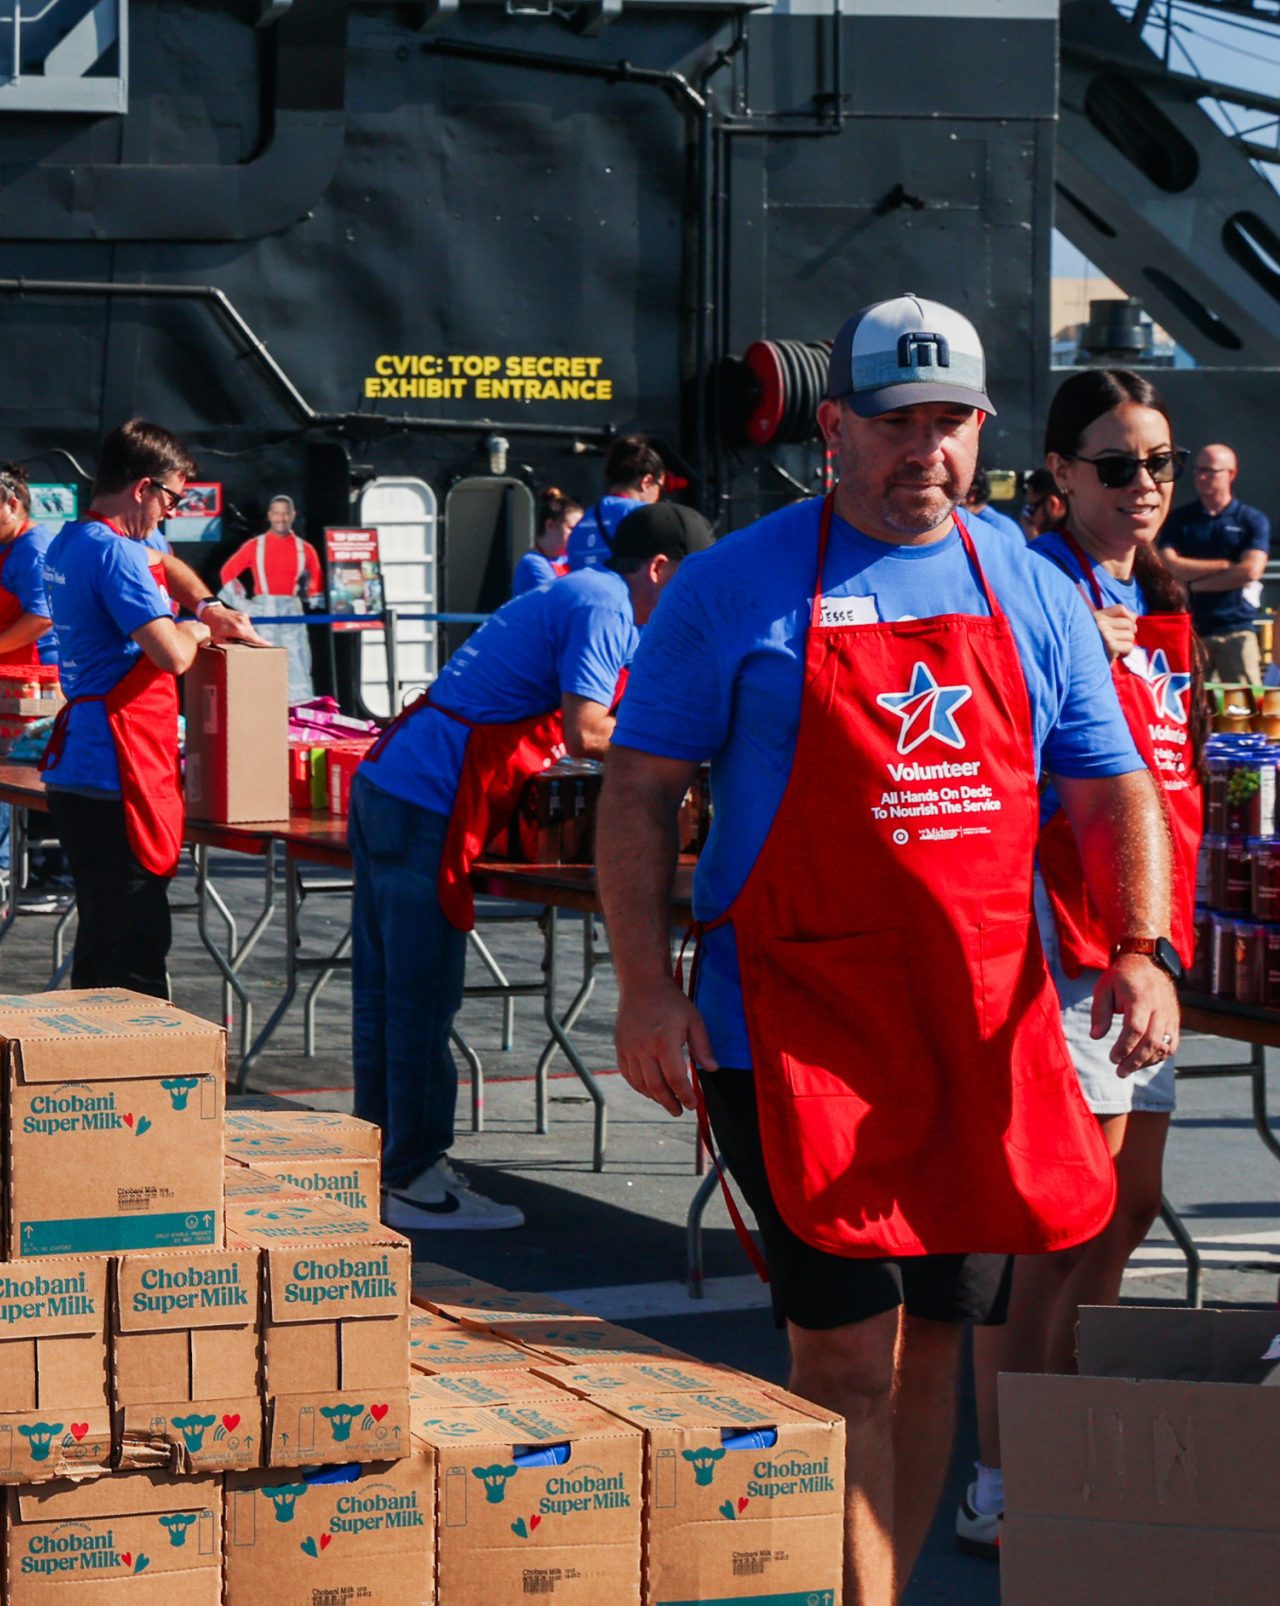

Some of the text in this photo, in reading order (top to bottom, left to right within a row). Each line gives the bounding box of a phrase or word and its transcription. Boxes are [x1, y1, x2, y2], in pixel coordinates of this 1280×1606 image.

[375, 355, 603, 377] CVIC: TOP SECRET
[365, 377, 612, 400] EXHIBIT ENTRANCE
[886, 760, 980, 782] Volunteer
[881, 792, 898, 804] All
[900, 789, 939, 803] Hands
[940, 788, 959, 800] On
[871, 798, 1001, 819] To Nourish The Service
[30, 1092, 115, 1115] Chobani
[23, 1111, 123, 1135] Super Milk
[141, 1262, 239, 1290] Chobani
[293, 1255, 389, 1281] Chobani
[132, 1286, 248, 1314] Super Milk
[284, 1277, 397, 1305] Super Milk
[47, 1295, 95, 1317] Milk
[753, 1457, 829, 1479] Chobani
[545, 1472, 624, 1495] Chobani
[747, 1476, 834, 1499] Super Milk
[336, 1490, 417, 1514] Chobani
[539, 1492, 631, 1515] Super Milk
[329, 1510, 424, 1534] Super Milk
[28, 1530, 113, 1554] Chobani
[21, 1551, 121, 1575] Super Milk
